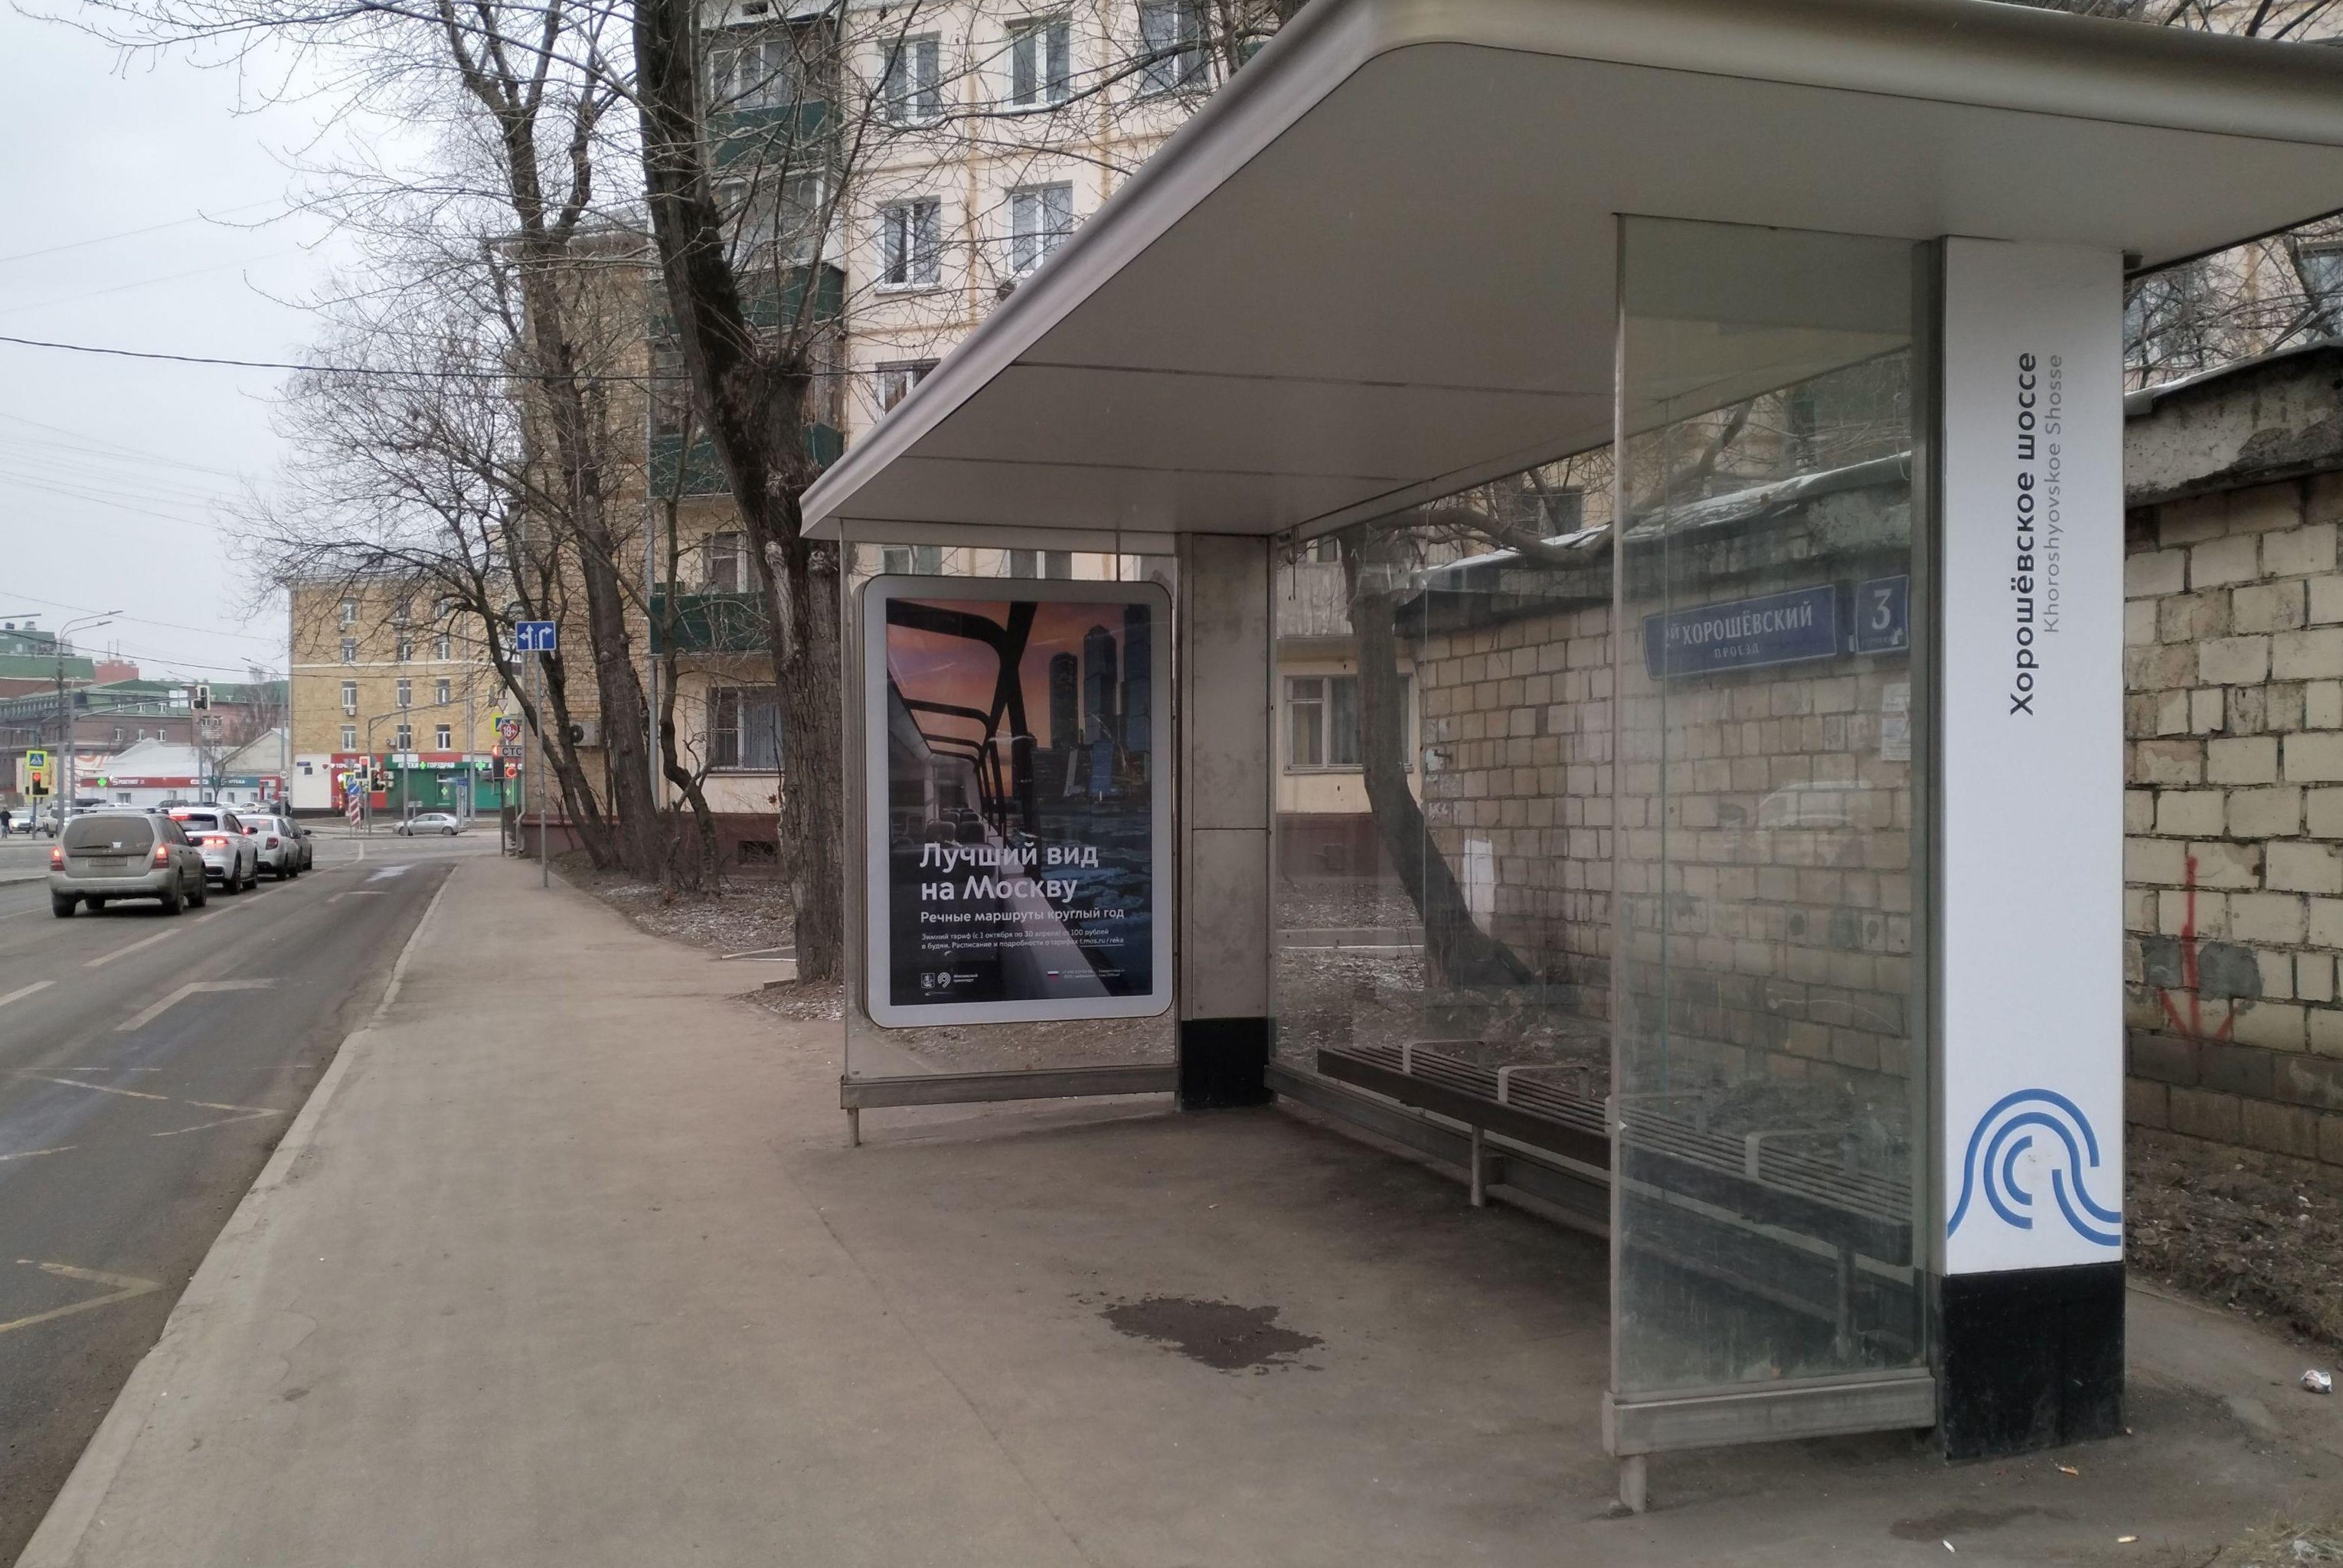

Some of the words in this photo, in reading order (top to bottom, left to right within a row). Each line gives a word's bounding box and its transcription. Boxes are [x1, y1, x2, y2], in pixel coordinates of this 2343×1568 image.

[2018, 352, 2037, 460] шоссе
[2044, 354, 2062, 435] Shosse
[2044, 443, 2064, 633] Khoroshyovskoe
[1871, 588, 1892, 629] 3
[2010, 471, 2040, 716] Хорошёвское
[1682, 600, 1812, 645] ХОРОШЁВСКИЙ
[1714, 642, 1760, 658] ПРОЕЗД
[920, 841, 1038, 873] Лучший
[1047, 847, 1099, 868] вид
[922, 881, 955, 900] на
[962, 875, 1078, 903] Москву
[920, 911, 972, 923] Речные
[975, 911, 1044, 923] маршруты
[1047, 907, 1101, 921] круглый
[1104, 909, 1125, 919] год
